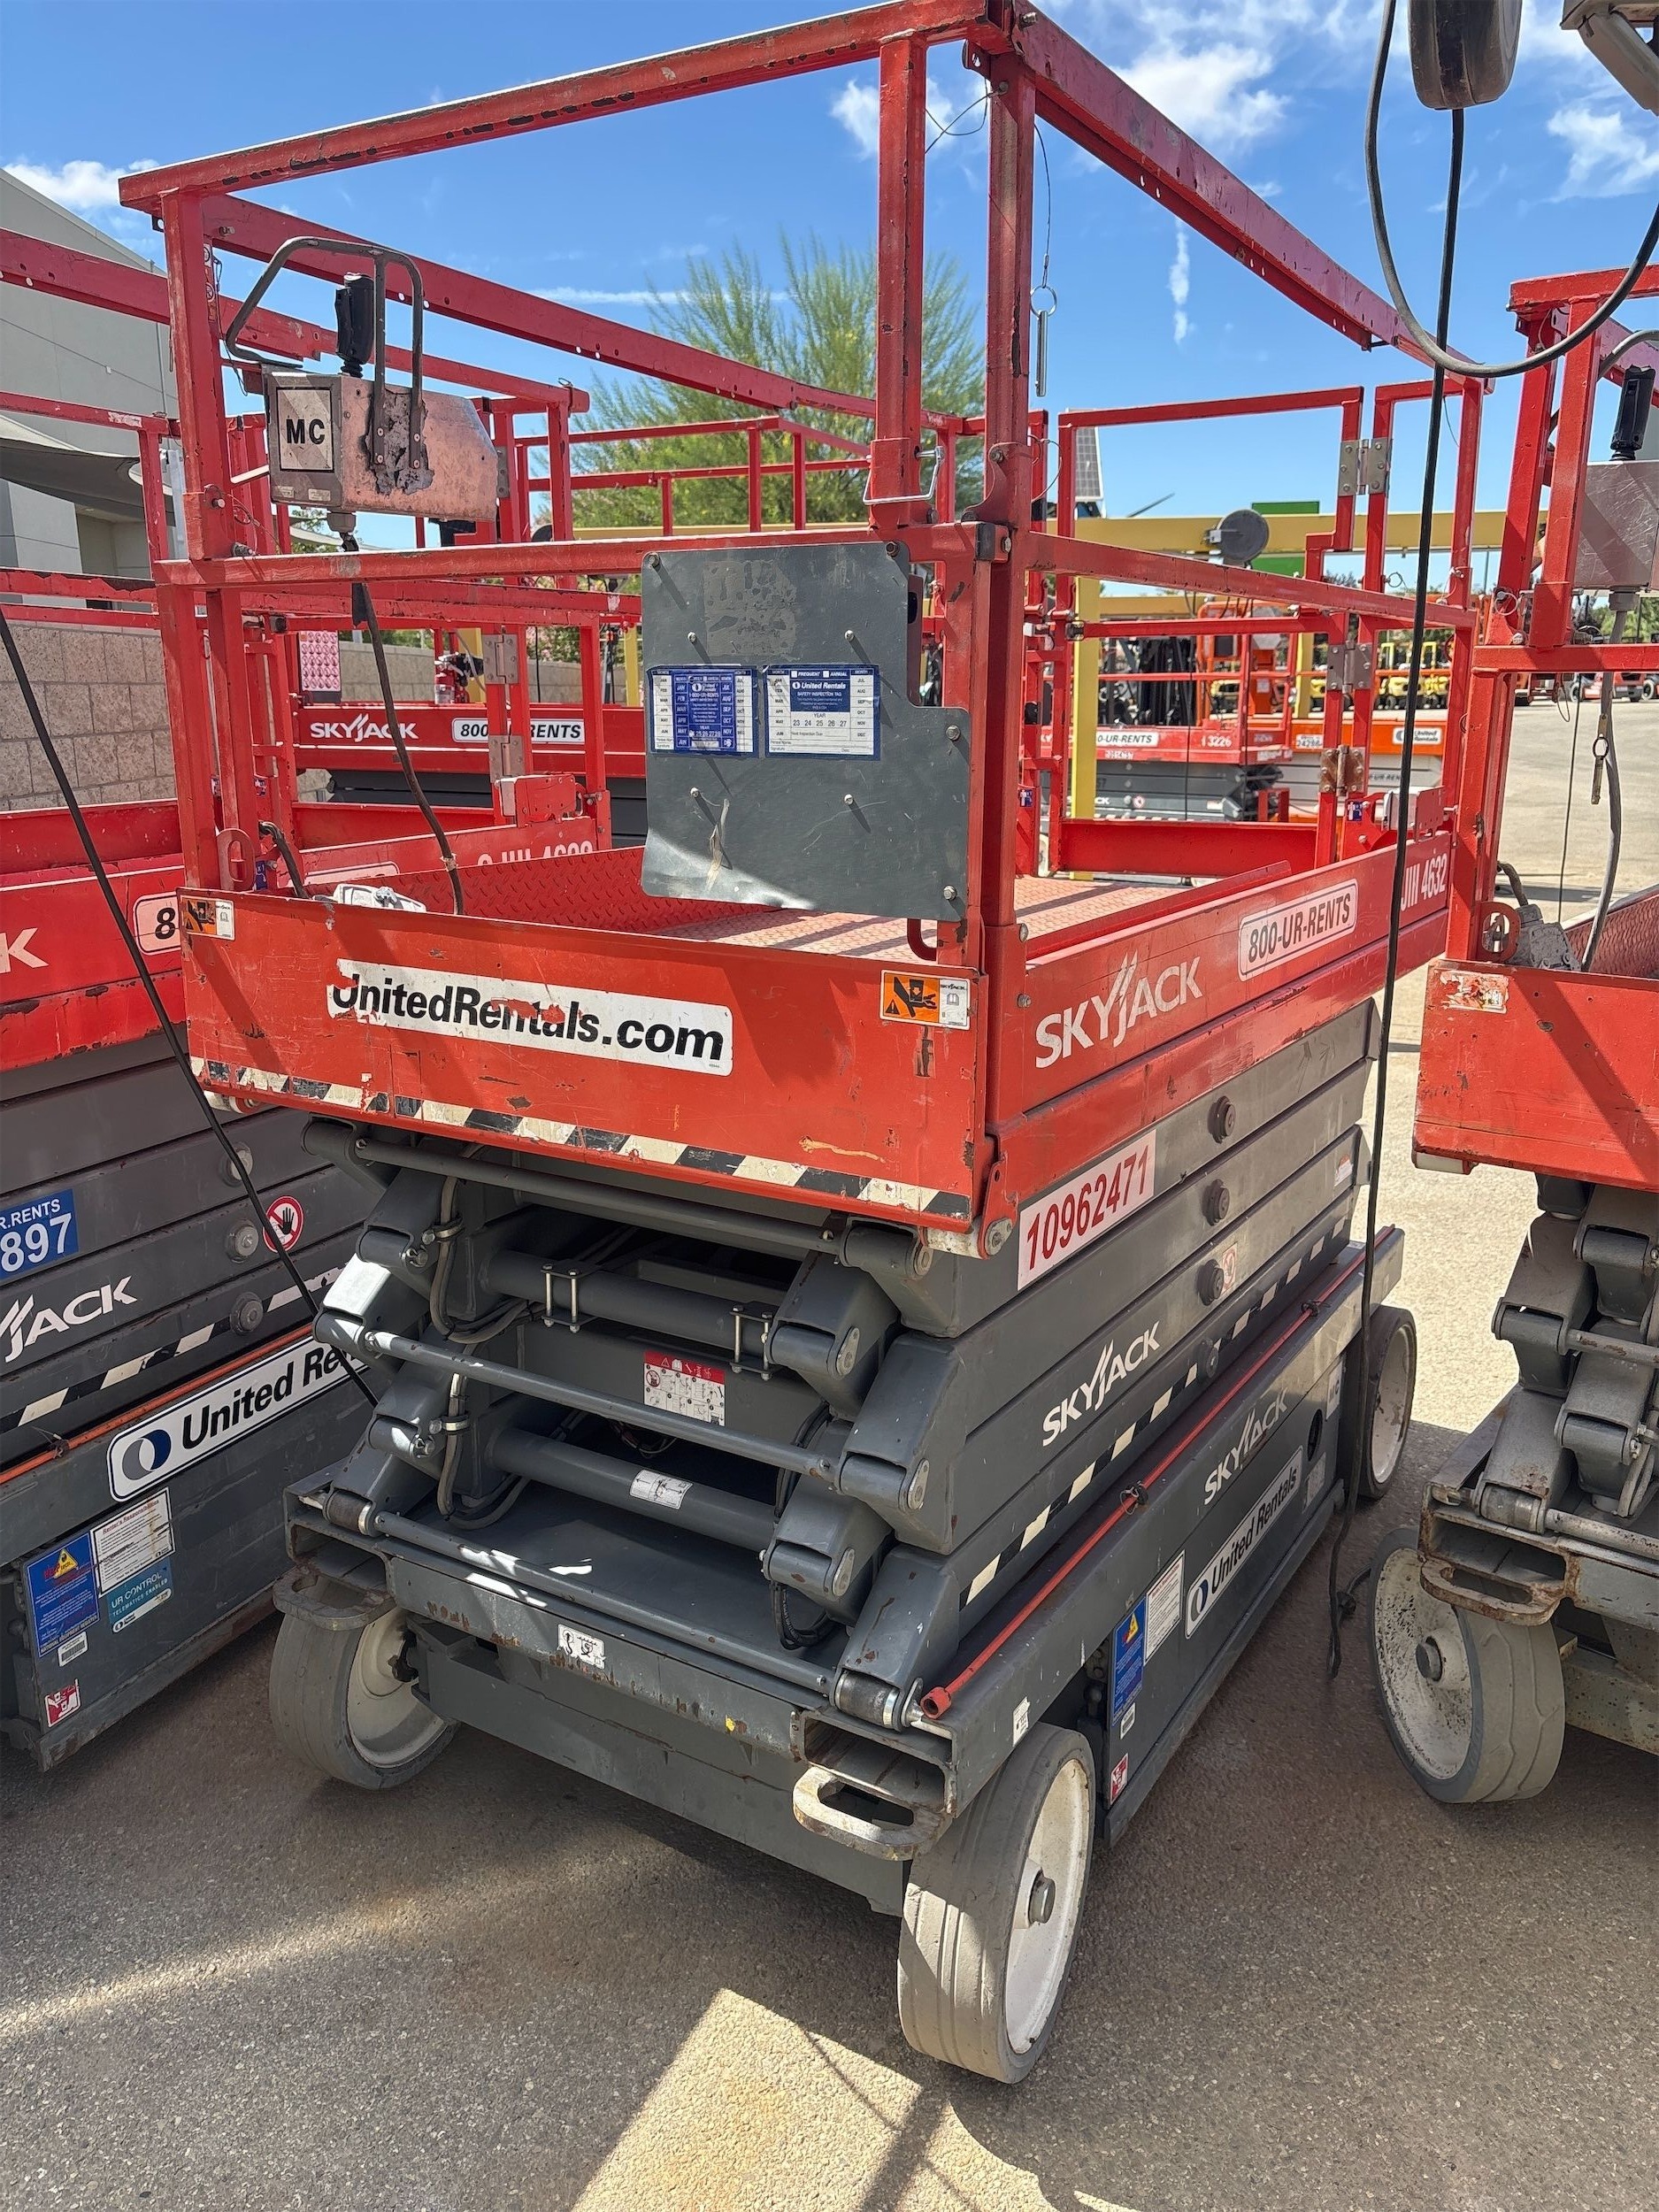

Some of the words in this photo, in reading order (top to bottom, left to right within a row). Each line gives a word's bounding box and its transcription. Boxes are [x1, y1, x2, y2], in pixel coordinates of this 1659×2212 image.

[286, 419, 326, 445] MC
[1207, 735, 1232, 747] 3226
[1421, 853, 1448, 901] 4632
[1248, 893, 1351, 964] 800-UR-RENTS
[332, 972, 724, 1061] UnitedRentals.com
[1035, 949, 1203, 1069] SKYJACK
[0, 1212, 73, 1272] 897
[1026, 1145, 1148, 1271] 10962471
[182, 1361, 295, 1449] United
[1042, 1321, 1160, 1447] SKYJACK
[1204, 1386, 1287, 1504] SKYJACK
[1211, 1516, 1256, 1594] United
[1256, 1466, 1298, 1537] Rentals
[111, 1595, 124, 1609] UR
[124, 1571, 162, 1600] CONTROL
[113, 1593, 143, 1617] TELEMATICS
[145, 1578, 168, 1596] ENABLED
